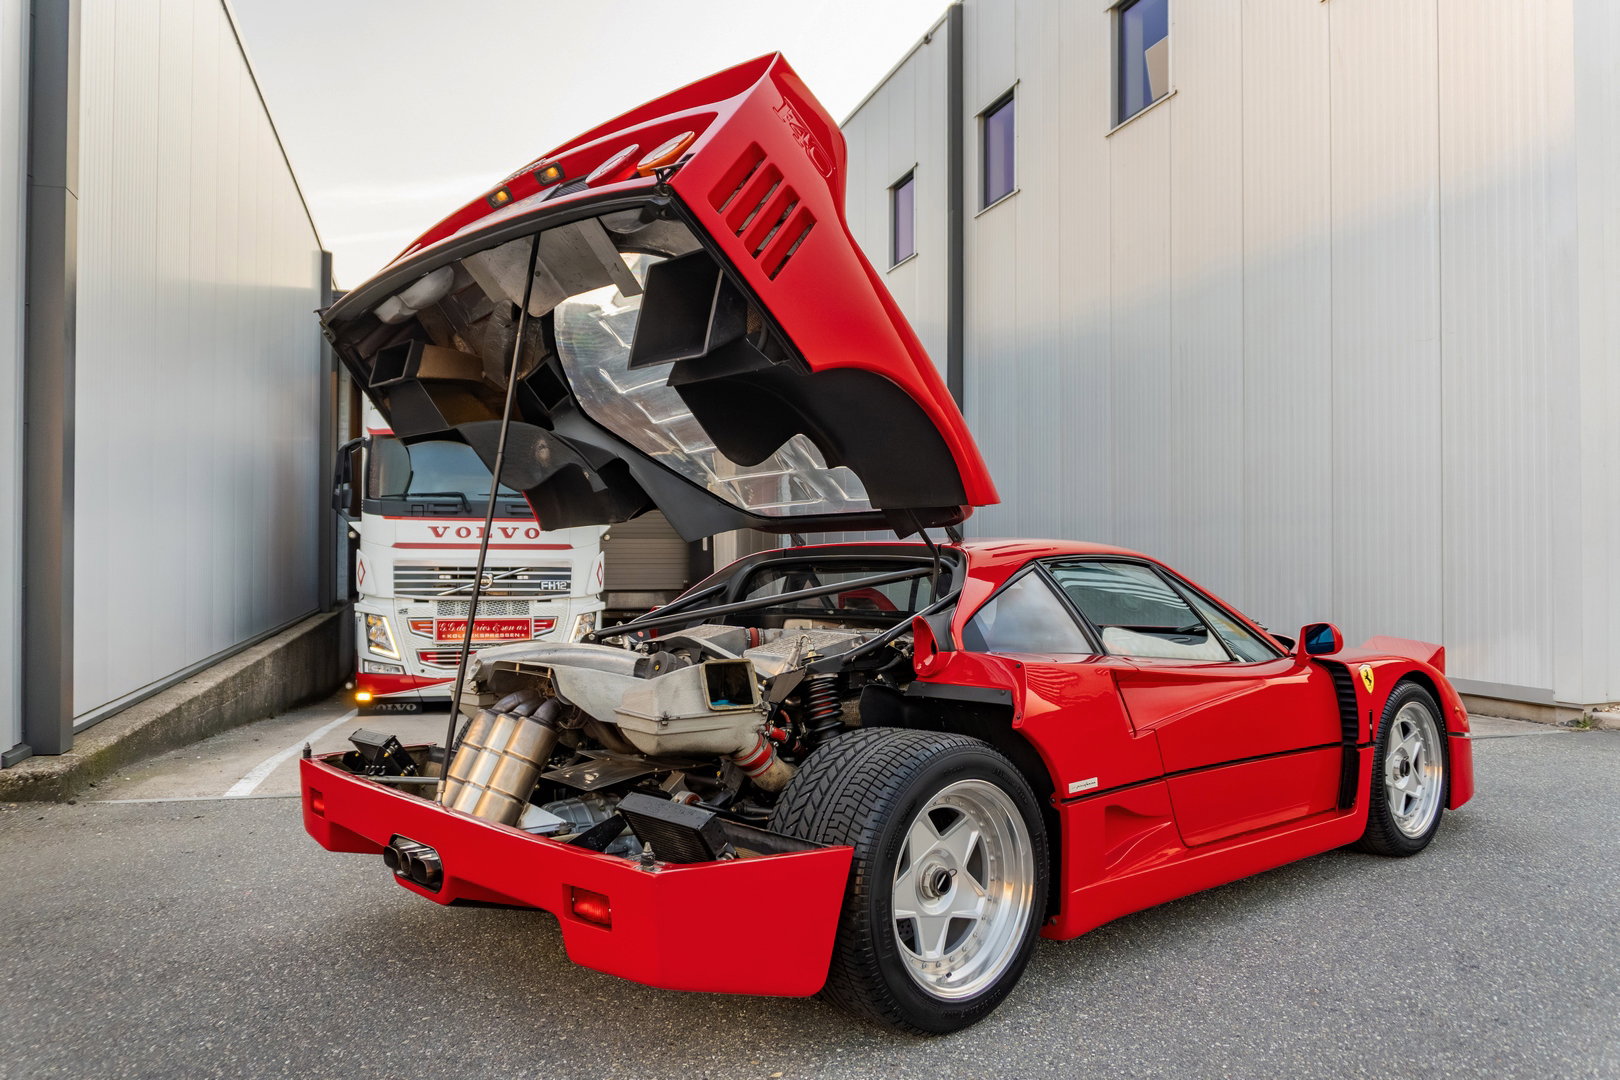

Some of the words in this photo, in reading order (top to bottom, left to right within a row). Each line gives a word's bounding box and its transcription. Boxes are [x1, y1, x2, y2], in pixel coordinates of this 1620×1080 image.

[428, 526, 540, 539] VOLVO
[541, 581, 567, 590] FH12
[492, 622, 500, 633] &
[368, 703, 417, 711] OLVO
